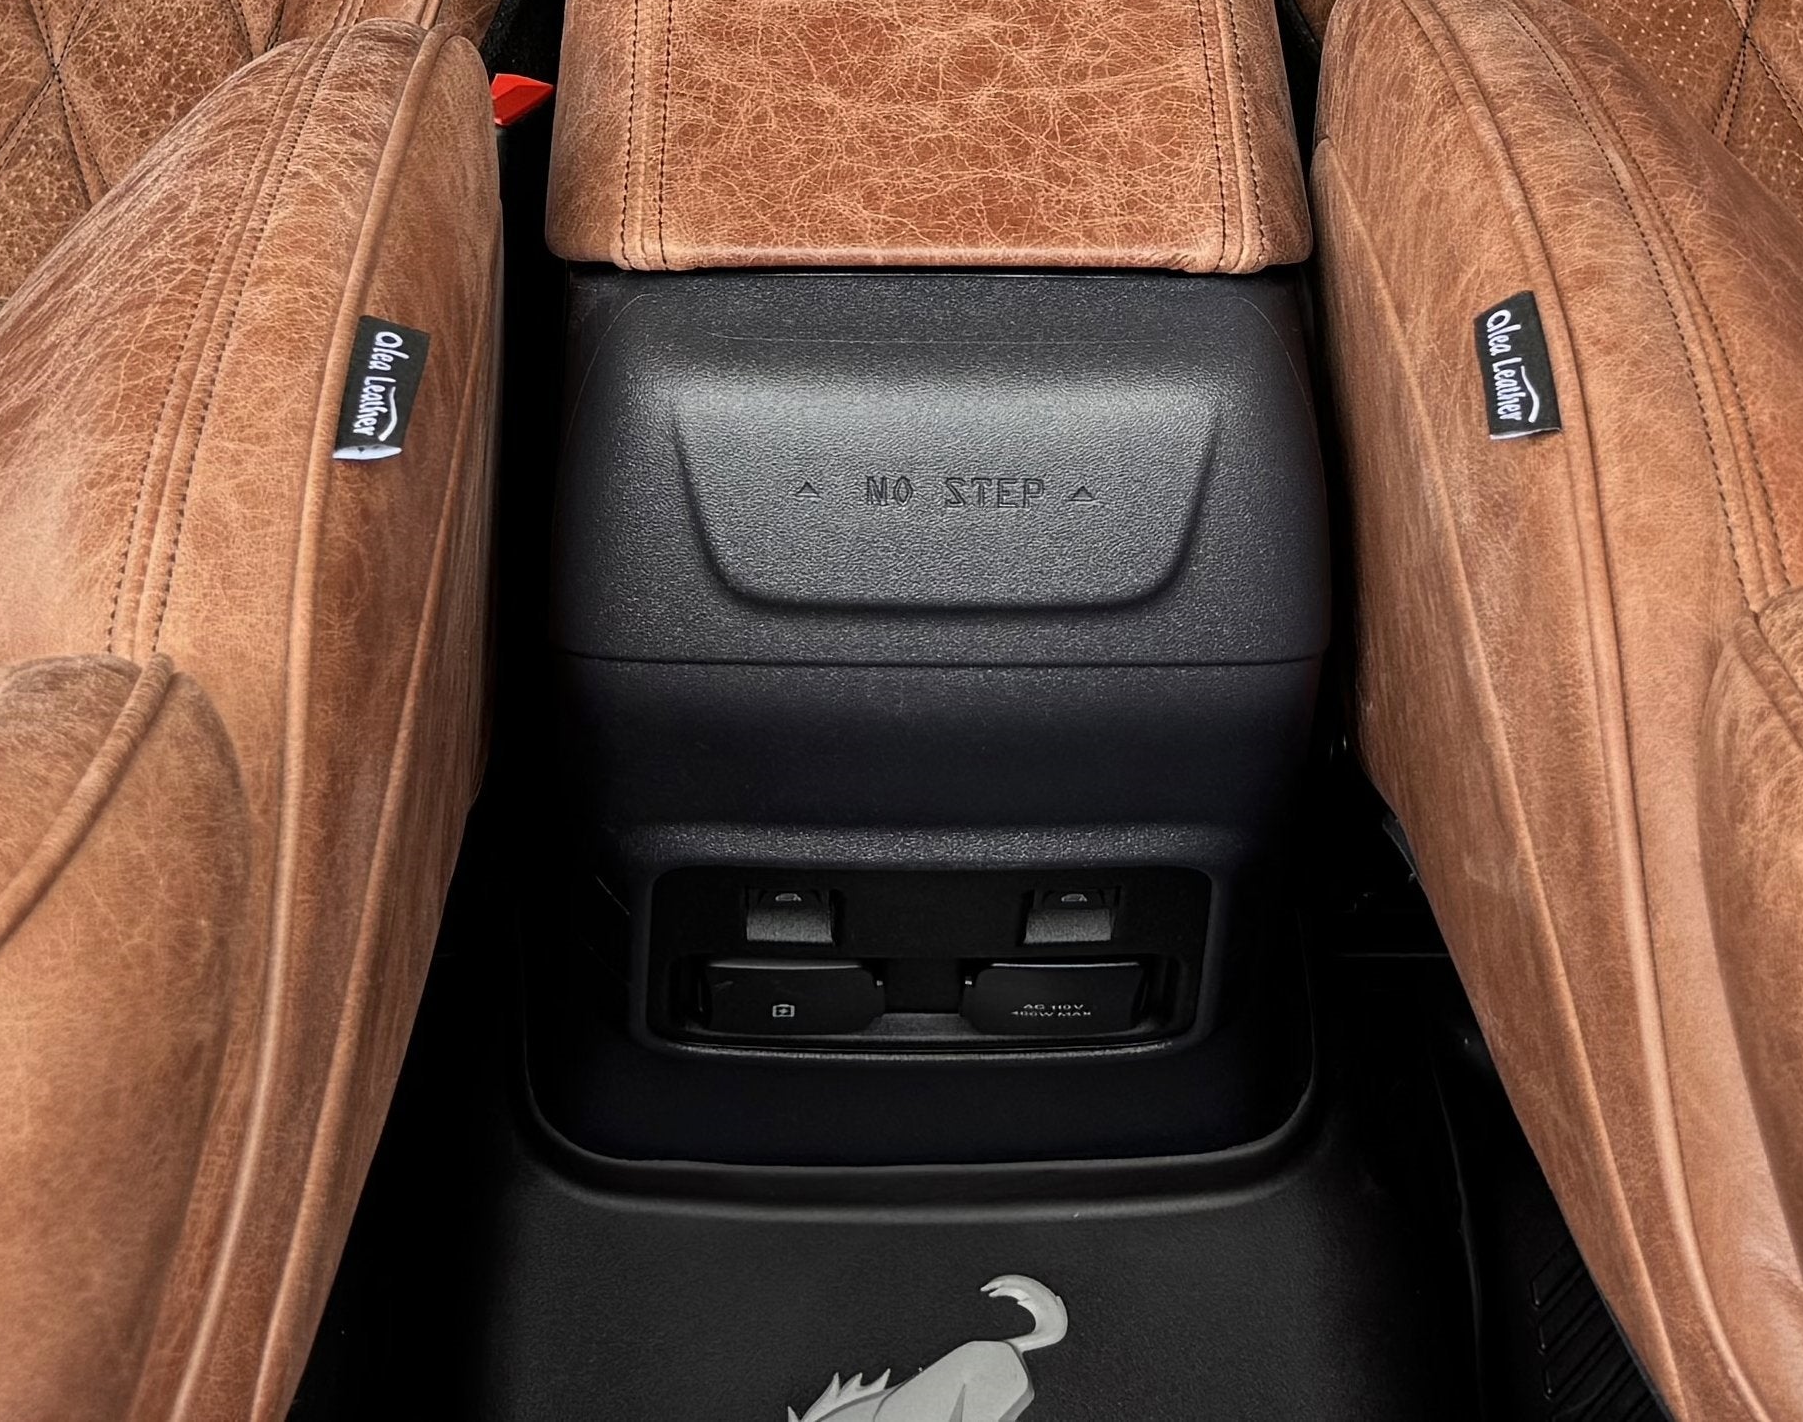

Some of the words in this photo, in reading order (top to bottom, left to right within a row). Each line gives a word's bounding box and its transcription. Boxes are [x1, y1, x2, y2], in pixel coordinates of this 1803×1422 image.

[352, 376, 397, 436] Leather
[1492, 357, 1526, 421] Leather
[865, 475, 915, 507] NO
[943, 476, 1046, 509] STEP
